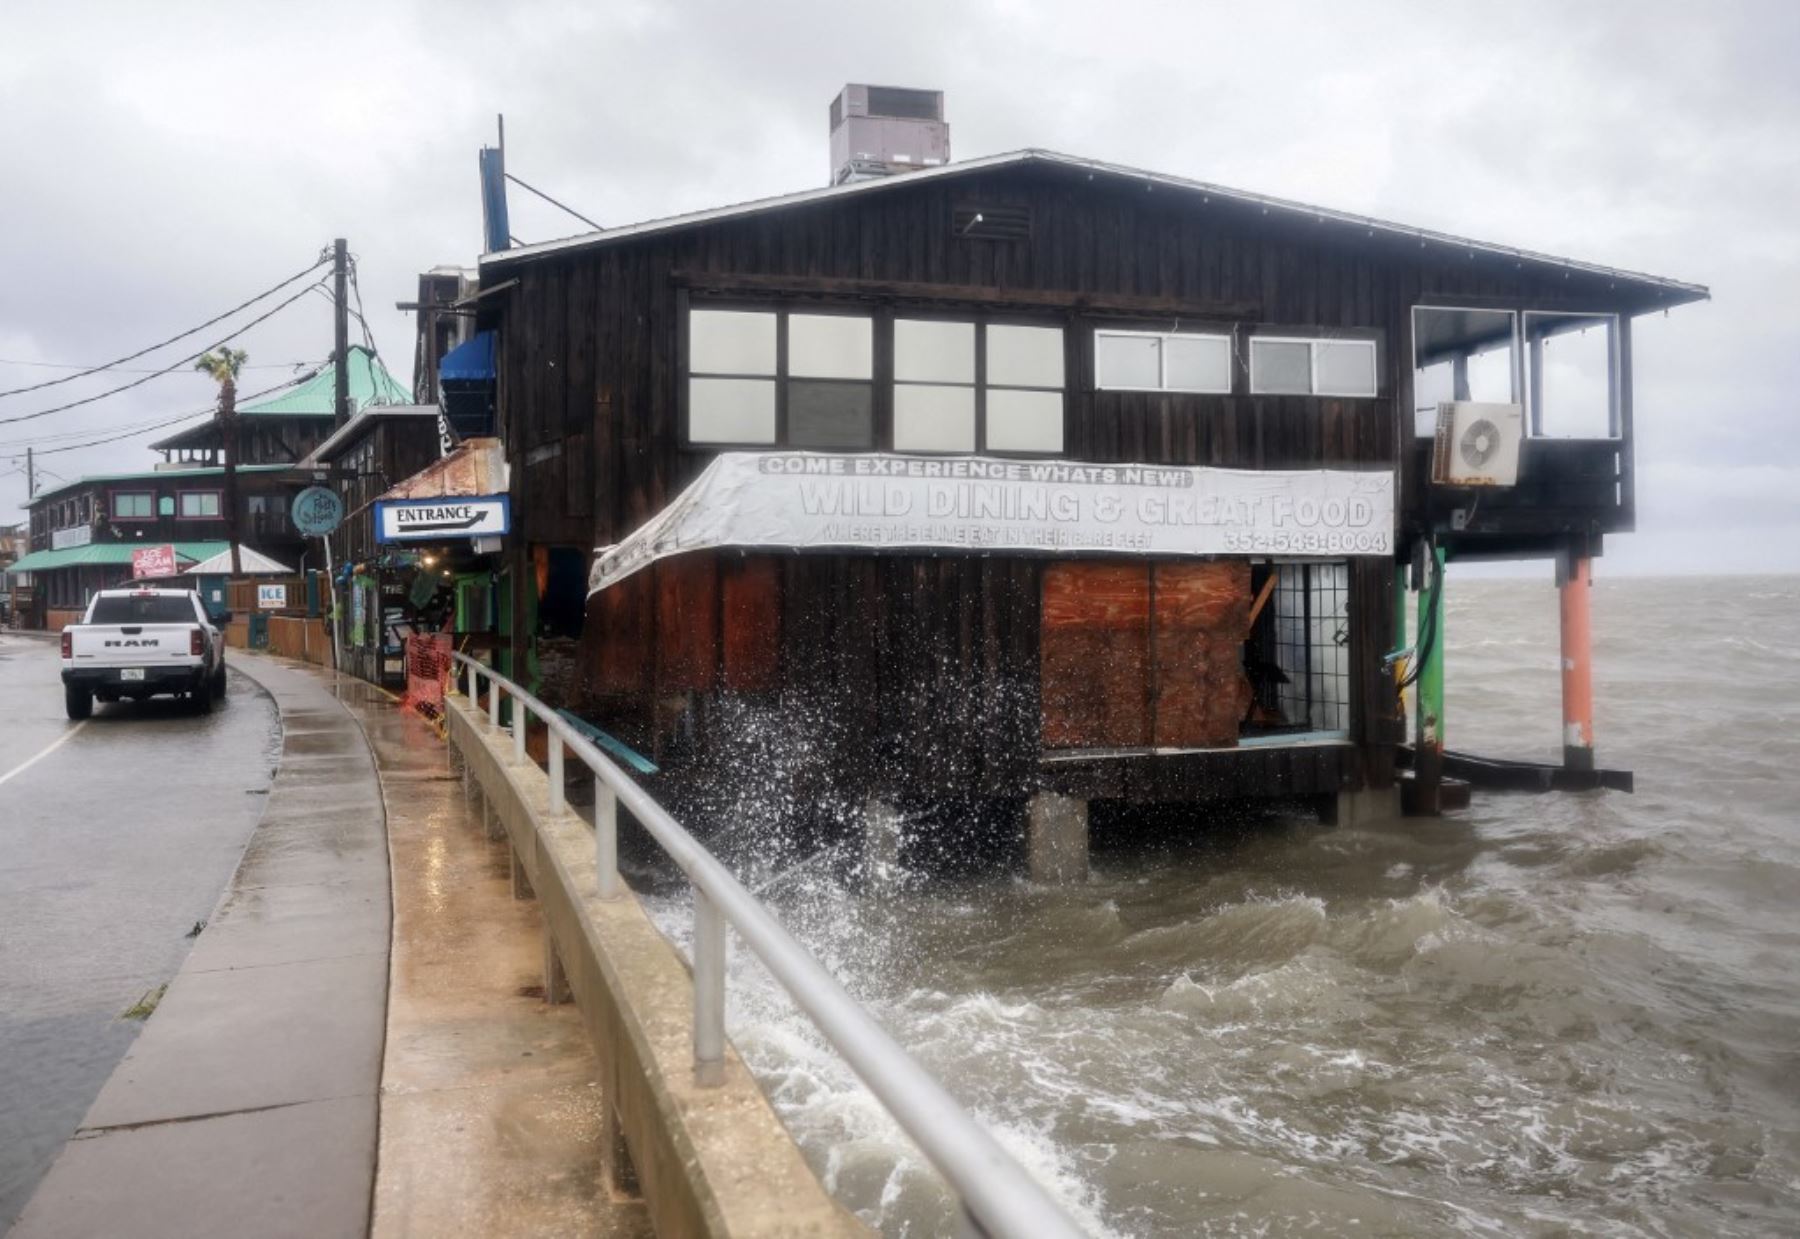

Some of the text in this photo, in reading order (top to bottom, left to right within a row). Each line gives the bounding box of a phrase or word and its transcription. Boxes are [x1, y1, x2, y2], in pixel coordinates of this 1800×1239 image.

[766, 457, 1187, 487] COME EXPERIENCE WHATS NEW!
[799, 479, 1375, 528] WILD DINING & GREAT FOOD
[396, 505, 472, 523] ENTRANCE
[822, 522, 882, 543] WHERE
[970, 525, 1002, 545] EAT
[1004, 526, 1019, 545] IN
[1023, 526, 1069, 546] THEIR
[142, 549, 161, 560] ICE
[134, 556, 171, 569] CREAM
[261, 587, 283, 600] ICE
[104, 639, 159, 648] RAM
